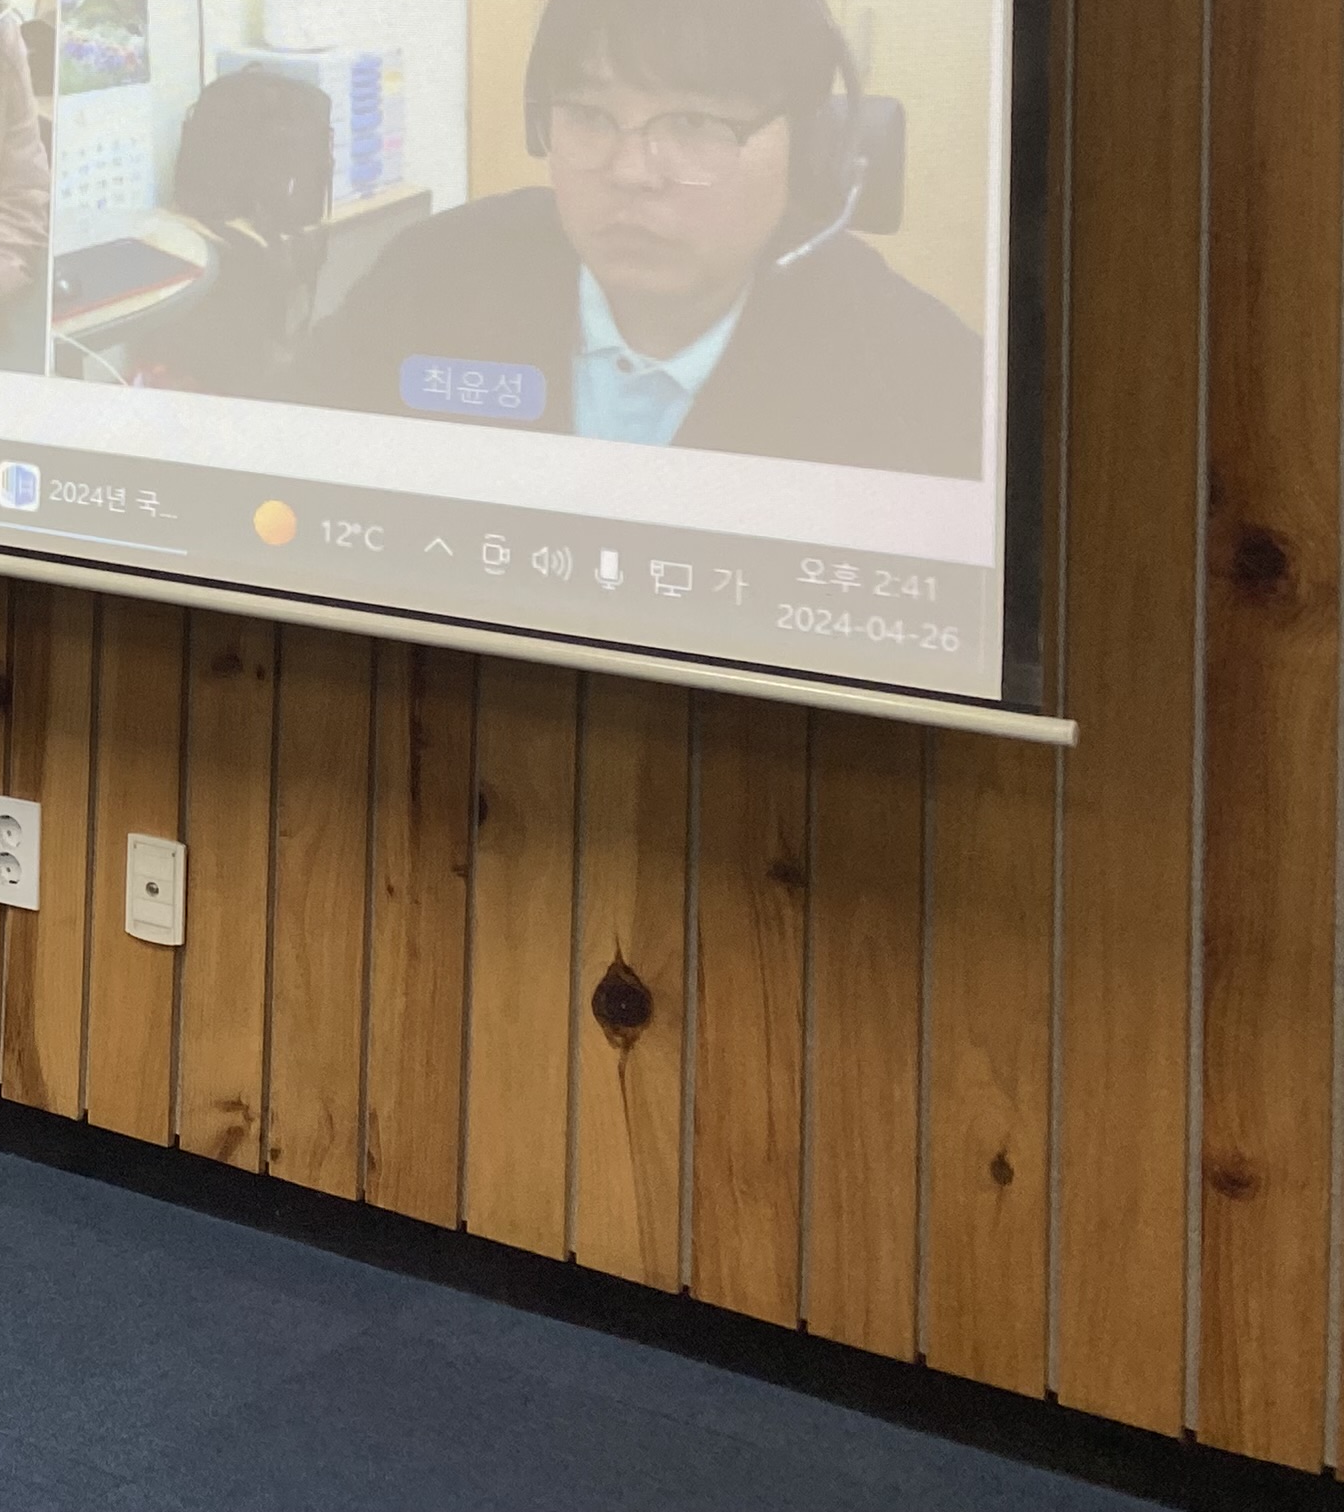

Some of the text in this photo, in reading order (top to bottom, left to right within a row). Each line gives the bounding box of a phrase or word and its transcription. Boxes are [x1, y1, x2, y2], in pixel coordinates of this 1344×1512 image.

[420, 364, 525, 409] 최윤성
[49, 479, 126, 513] 2024년
[715, 568, 749, 606] 가
[797, 558, 937, 601] 오후 2:41
[775, 603, 959, 652] 2024-04-26
